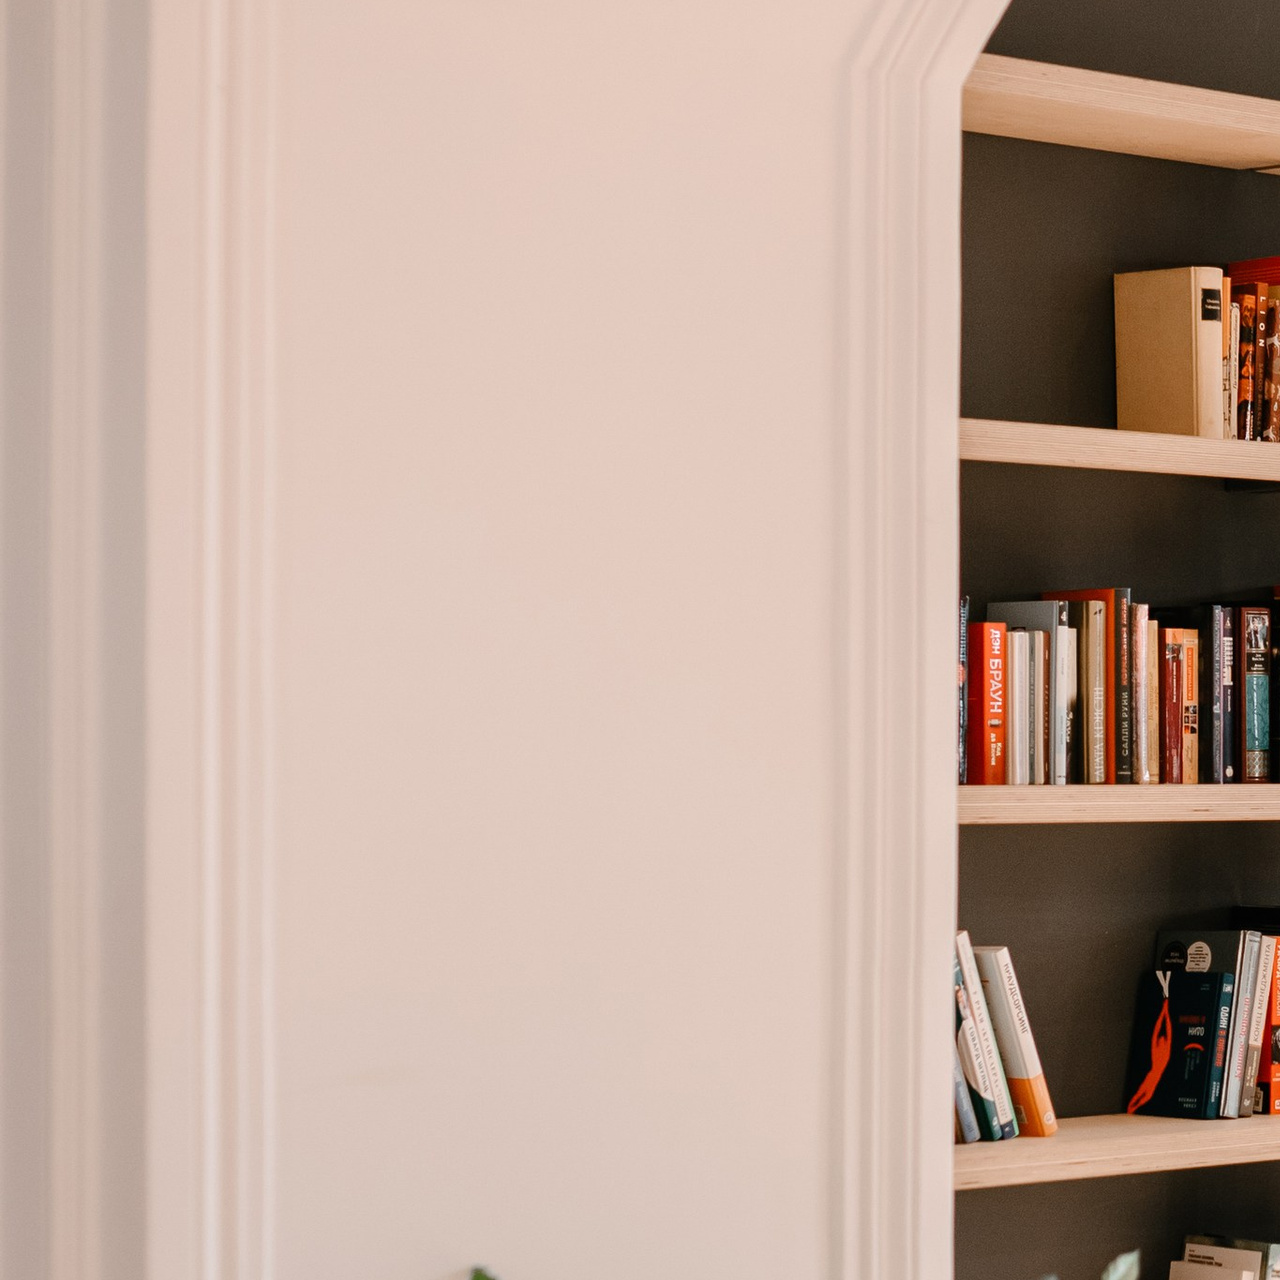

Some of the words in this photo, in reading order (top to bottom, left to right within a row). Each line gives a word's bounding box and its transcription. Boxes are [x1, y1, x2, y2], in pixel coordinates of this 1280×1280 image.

[1258, 296, 1267, 347] LION
[990, 629, 1001, 655] ДЭН
[990, 659, 1003, 713] БРАУН
[1121, 691, 1129, 718] РУНИ
[1093, 686, 1104, 738] КРИСТИ
[1121, 721, 1129, 757] САЛЛИ
[1003, 962, 1029, 1036] КРАУДСОРСИНГ
[1257, 943, 1272, 1010] МЕНЕДЖМЕНТА
[1220, 1006, 1230, 1028] ОДИН
[1253, 1011, 1263, 1042] КОНЕЦ
[967, 1025, 981, 1060] ГОВАРД
[975, 1060, 989, 1095] ШУЛЬЦ
